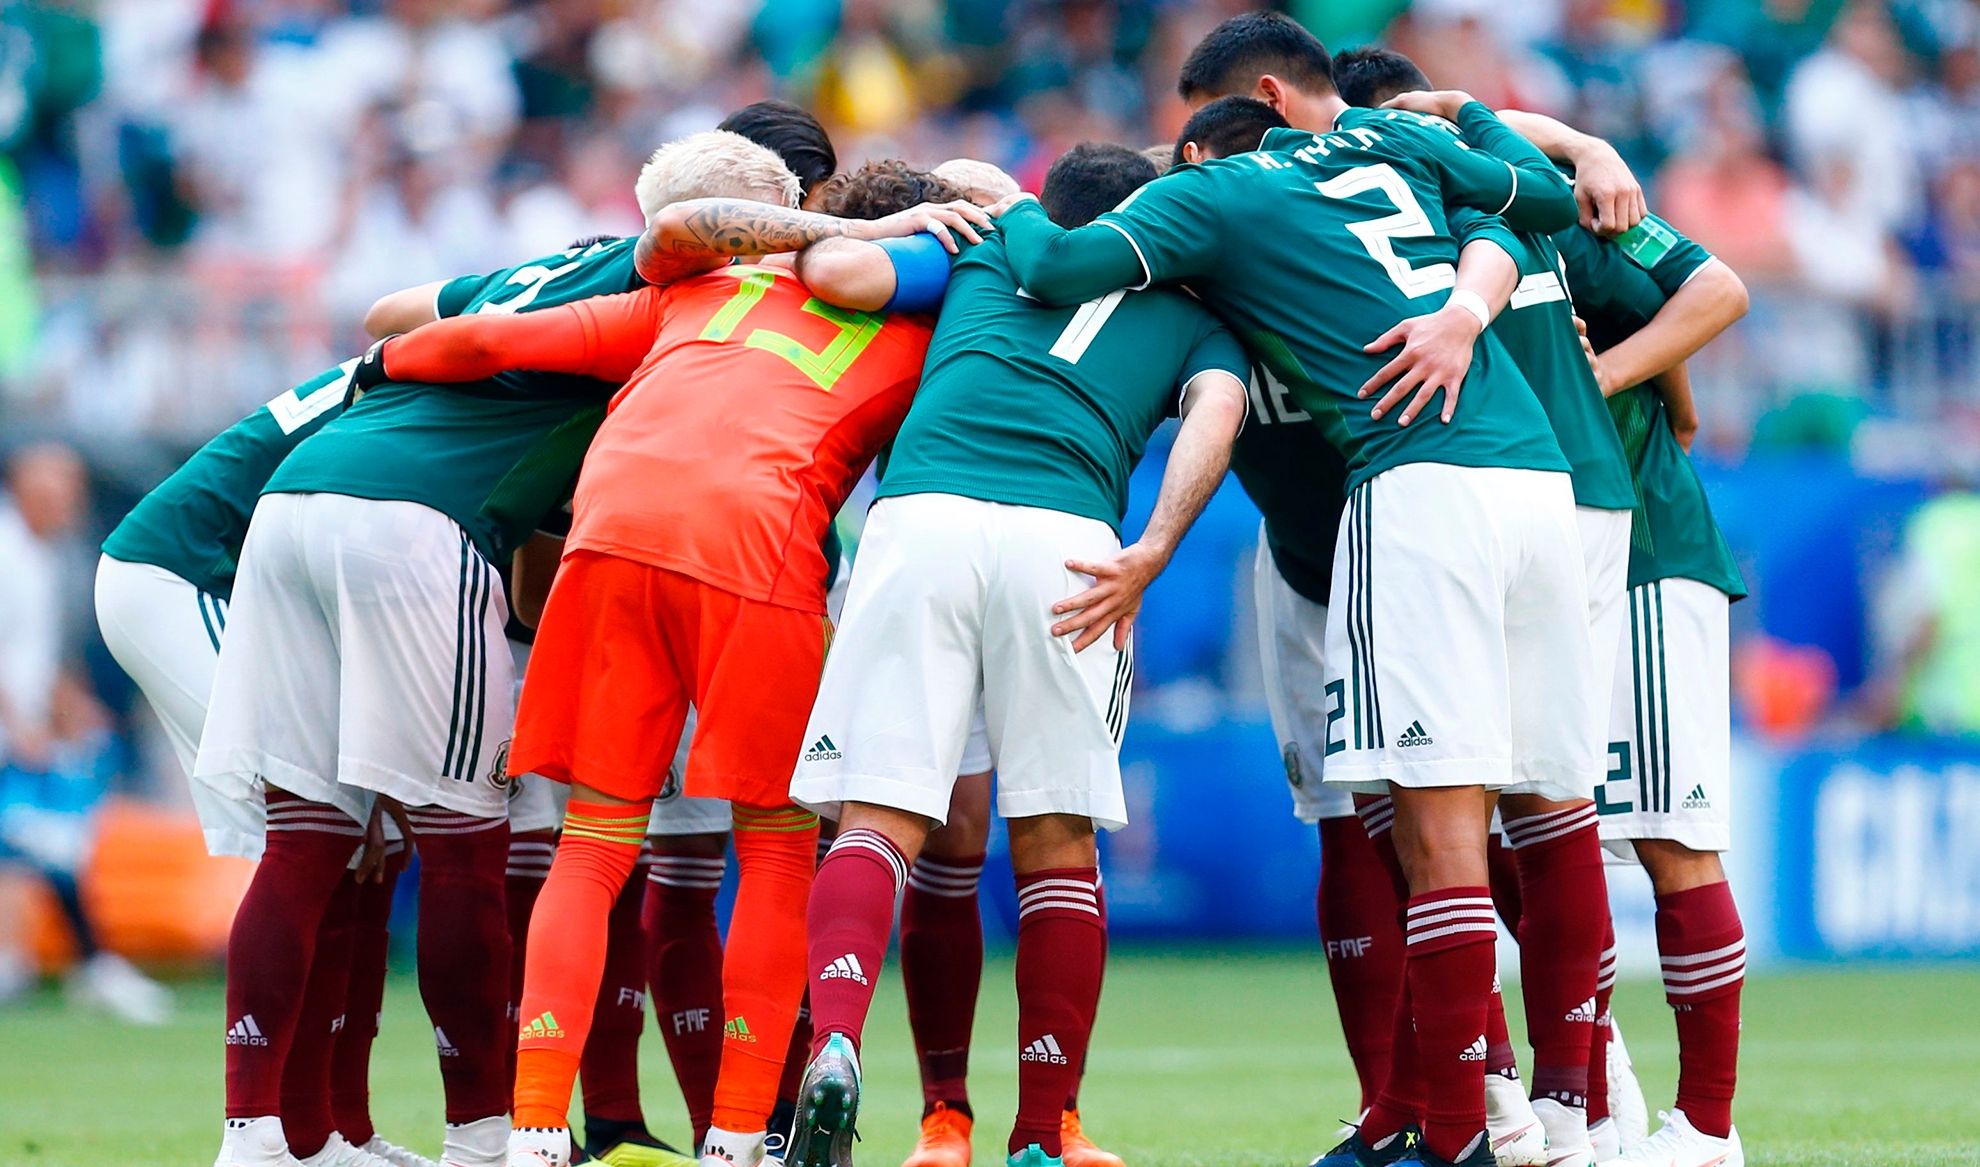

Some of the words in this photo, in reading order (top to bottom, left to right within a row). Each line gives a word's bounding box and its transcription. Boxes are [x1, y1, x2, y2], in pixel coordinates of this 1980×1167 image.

[1313, 162, 1457, 300] 2
[1323, 678, 1346, 757] 2
[1396, 736, 1434, 748] adidas
[804, 751, 842, 762] adidas
[1326, 936, 1373, 960] FMF
[819, 967, 869, 986] adidas
[672, 1008, 711, 1036] FMF
[1020, 1051, 1068, 1065] adidas
